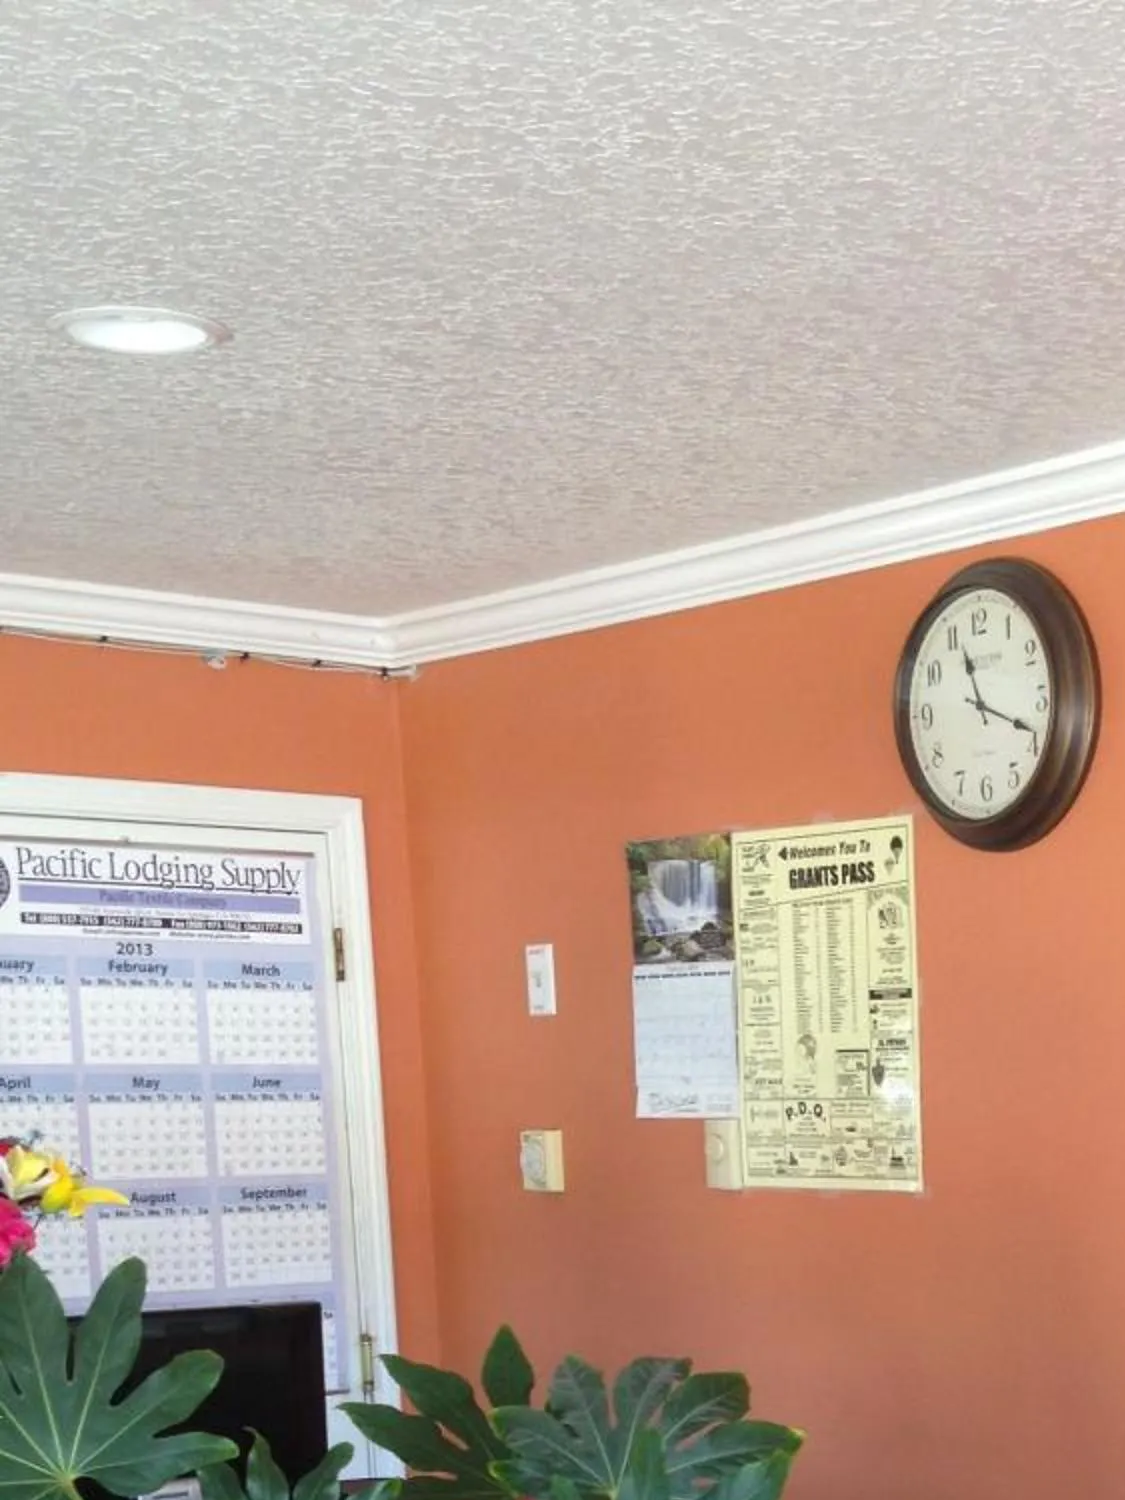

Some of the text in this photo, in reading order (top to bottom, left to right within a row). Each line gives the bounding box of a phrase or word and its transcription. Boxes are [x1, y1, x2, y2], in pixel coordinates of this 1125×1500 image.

[971, 608, 987, 636] 12
[1025, 639, 1037, 667] 2
[927, 660, 942, 687] 10
[1036, 684, 1048, 712] 3
[921, 704, 933, 730] 9
[931, 745, 944, 768] 8
[954, 770, 965, 796] 7
[1008, 761, 1020, 788] 5
[980, 775, 993, 801] 6
[839, 841, 857, 856] You
[16, 847, 301, 895] Pacific Lodging Supply
[789, 864, 839, 890] GRANTS
[841, 861, 876, 885] PASS
[116, 942, 153, 956] 2013
[0, 959, 35, 972] uary
[108, 959, 169, 975] February
[241, 964, 281, 977] March
[132, 1076, 160, 1091] May
[252, 1076, 281, 1089] June
[131, 1192, 177, 1206] August
[241, 1187, 307, 1201] September
